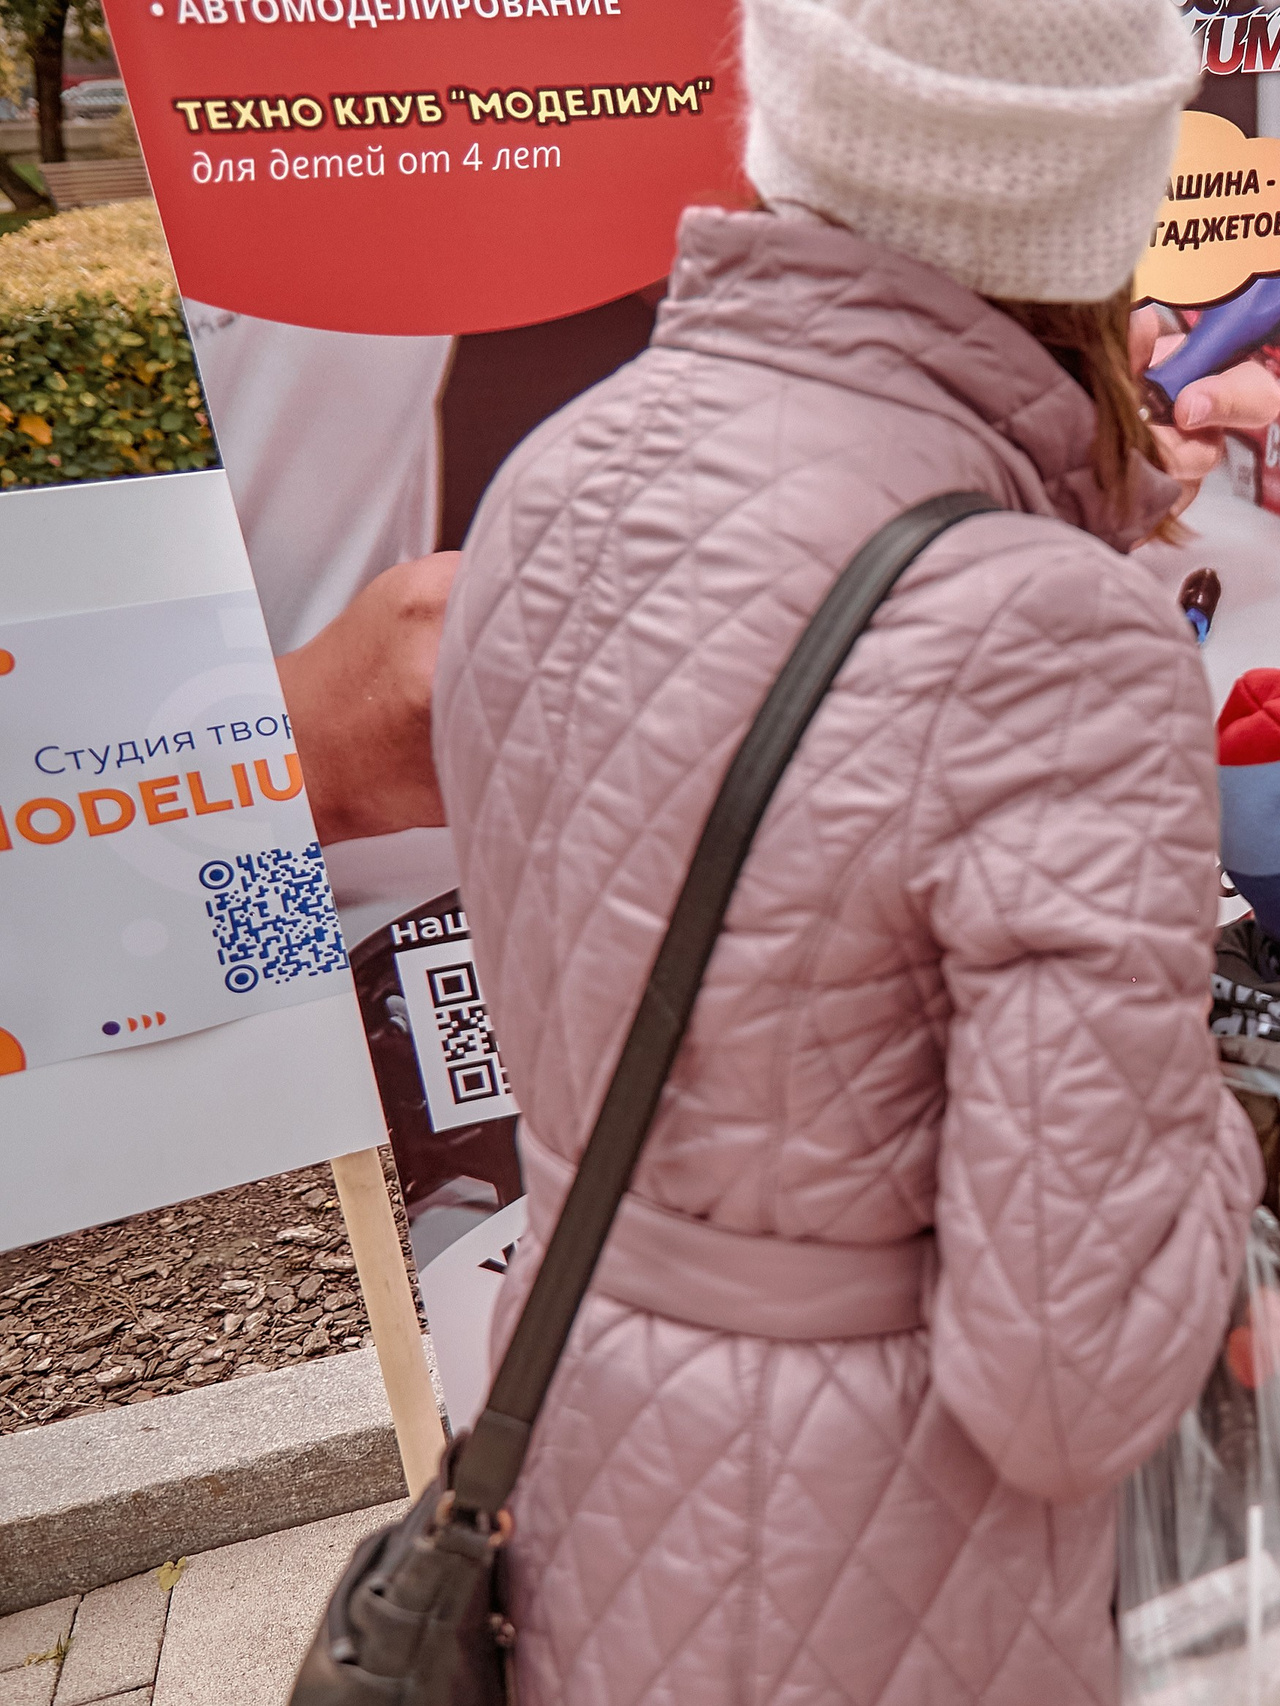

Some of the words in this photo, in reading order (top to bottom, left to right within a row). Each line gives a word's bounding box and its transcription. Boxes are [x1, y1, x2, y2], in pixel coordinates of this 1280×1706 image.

[175, 97, 324, 131] ТЕХНО
[333, 94, 442, 126] КЛУБ
[451, 80, 711, 123] "МОДЕЛИУМ"
[192, 150, 256, 184] для
[269, 144, 385, 180] детей
[399, 150, 451, 175] от
[462, 142, 484, 172] 4
[491, 144, 561, 171] лет
[34, 730, 196, 774] Студия
[0, 752, 304, 851] ODELIU
